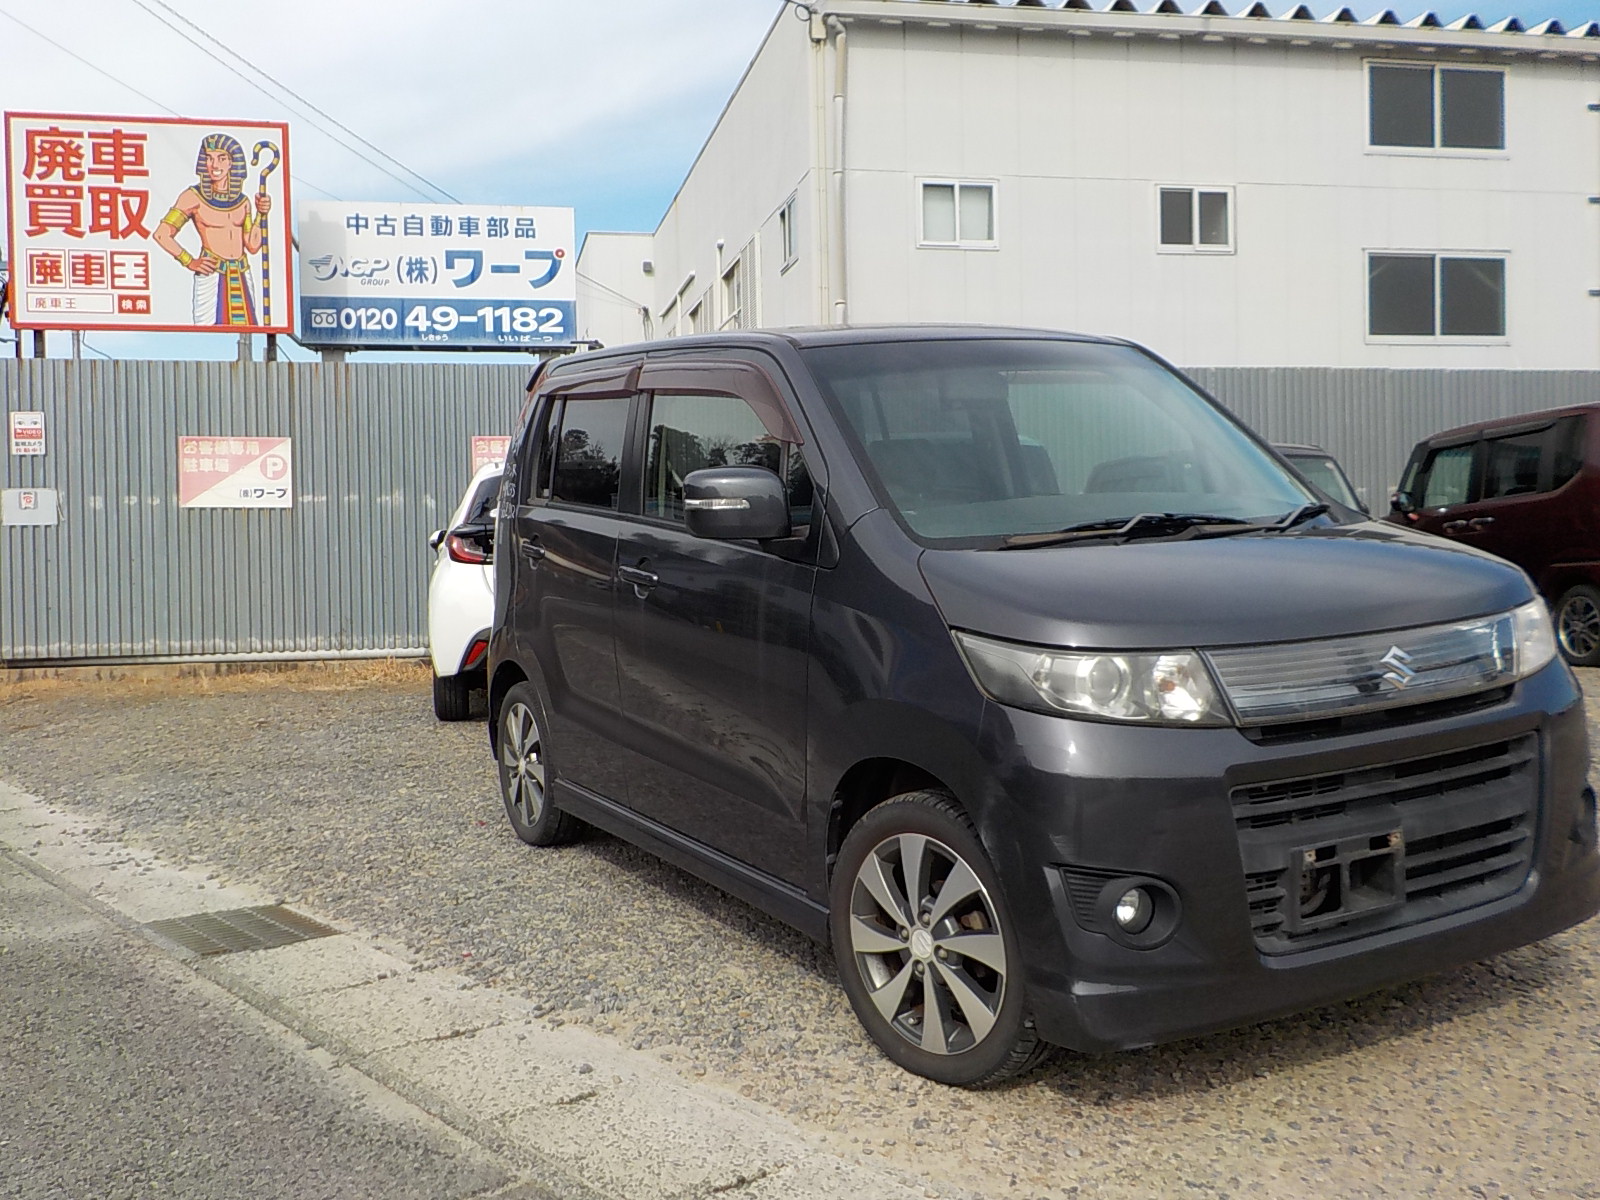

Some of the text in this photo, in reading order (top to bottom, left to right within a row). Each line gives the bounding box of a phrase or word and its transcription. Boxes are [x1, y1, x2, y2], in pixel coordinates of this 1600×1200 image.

[22, 126, 149, 184] 廃車
[24, 184, 151, 240] 買取
[346, 213, 536, 239] 中古自動車部品
[360, 278, 390, 286] GROUP
[35, 297, 77, 309] 廃車王
[340, 305, 564, 333] 0120 49-1182
[266, 457, 285, 478] P
